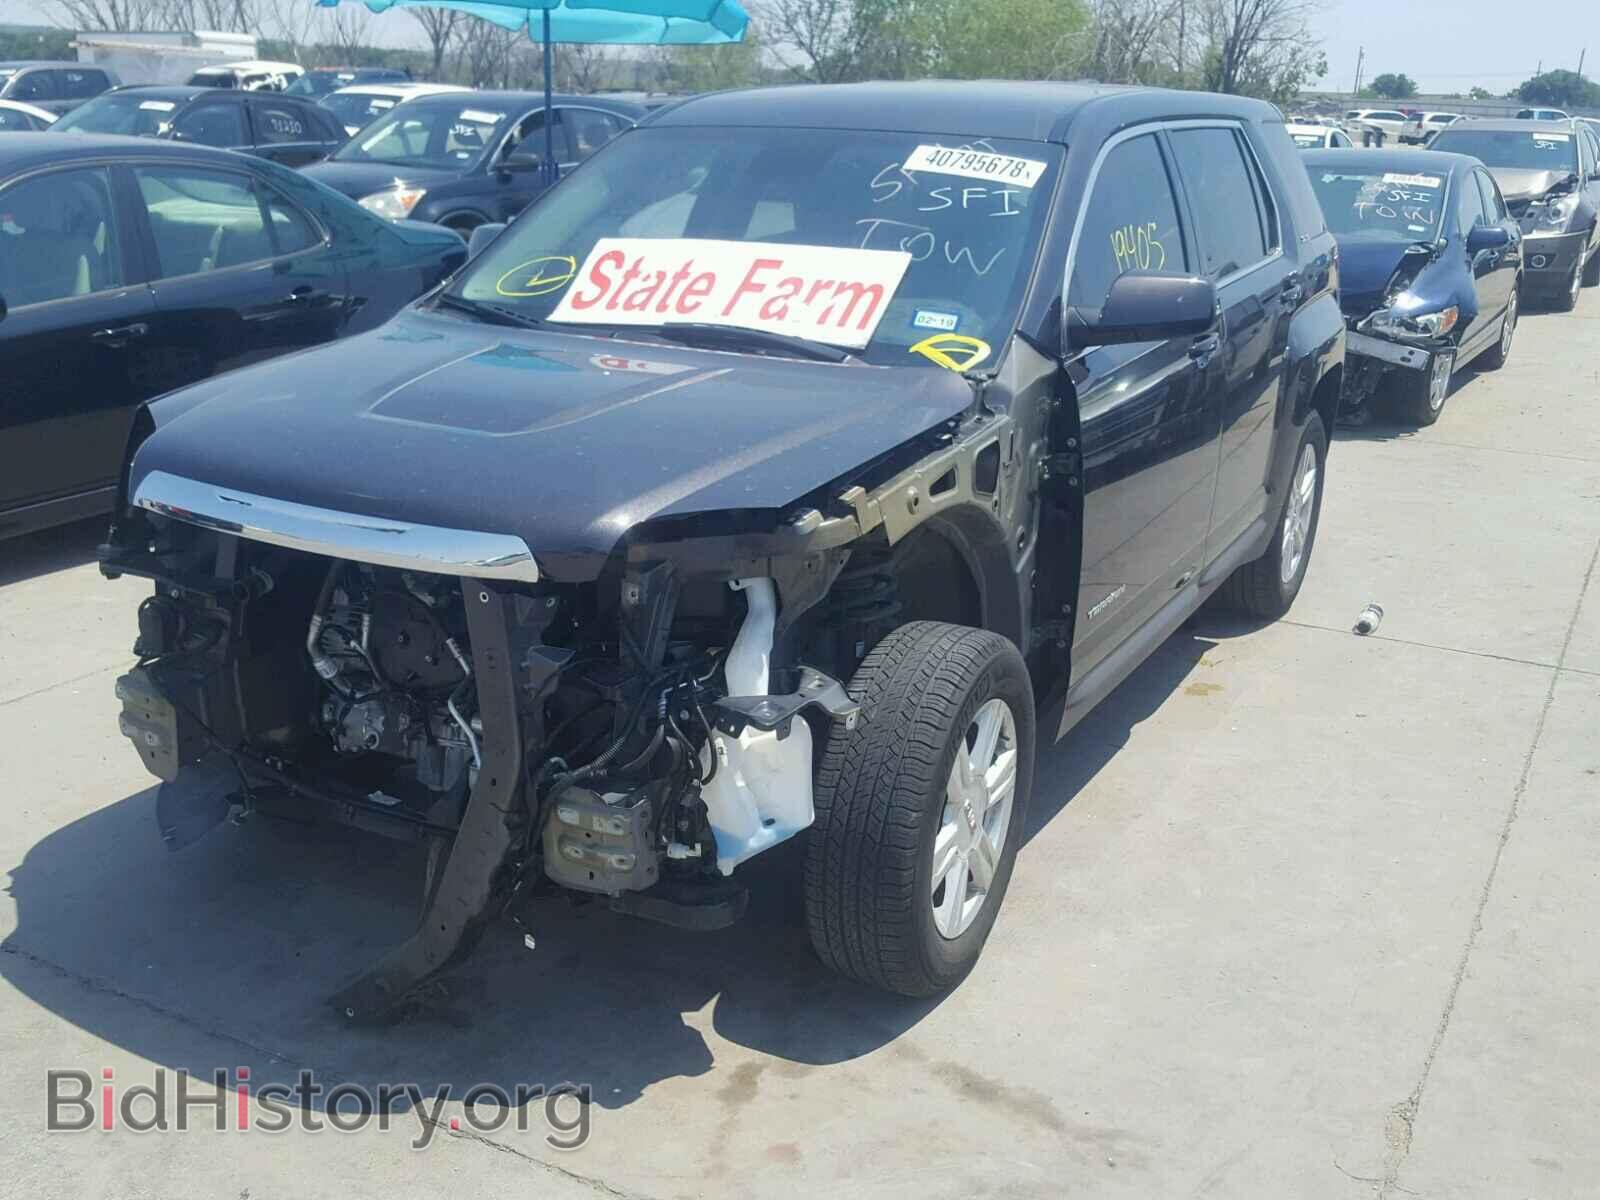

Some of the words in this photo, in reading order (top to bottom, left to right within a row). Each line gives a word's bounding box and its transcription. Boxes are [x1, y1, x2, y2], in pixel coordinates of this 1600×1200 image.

[925, 149, 1027, 178] 40795678
[918, 186, 1021, 217] SFI
[1387, 189, 1433, 202] SFI
[856, 217, 1007, 277] TOW
[570, 250, 717, 315] State
[721, 258, 885, 331] Farm
